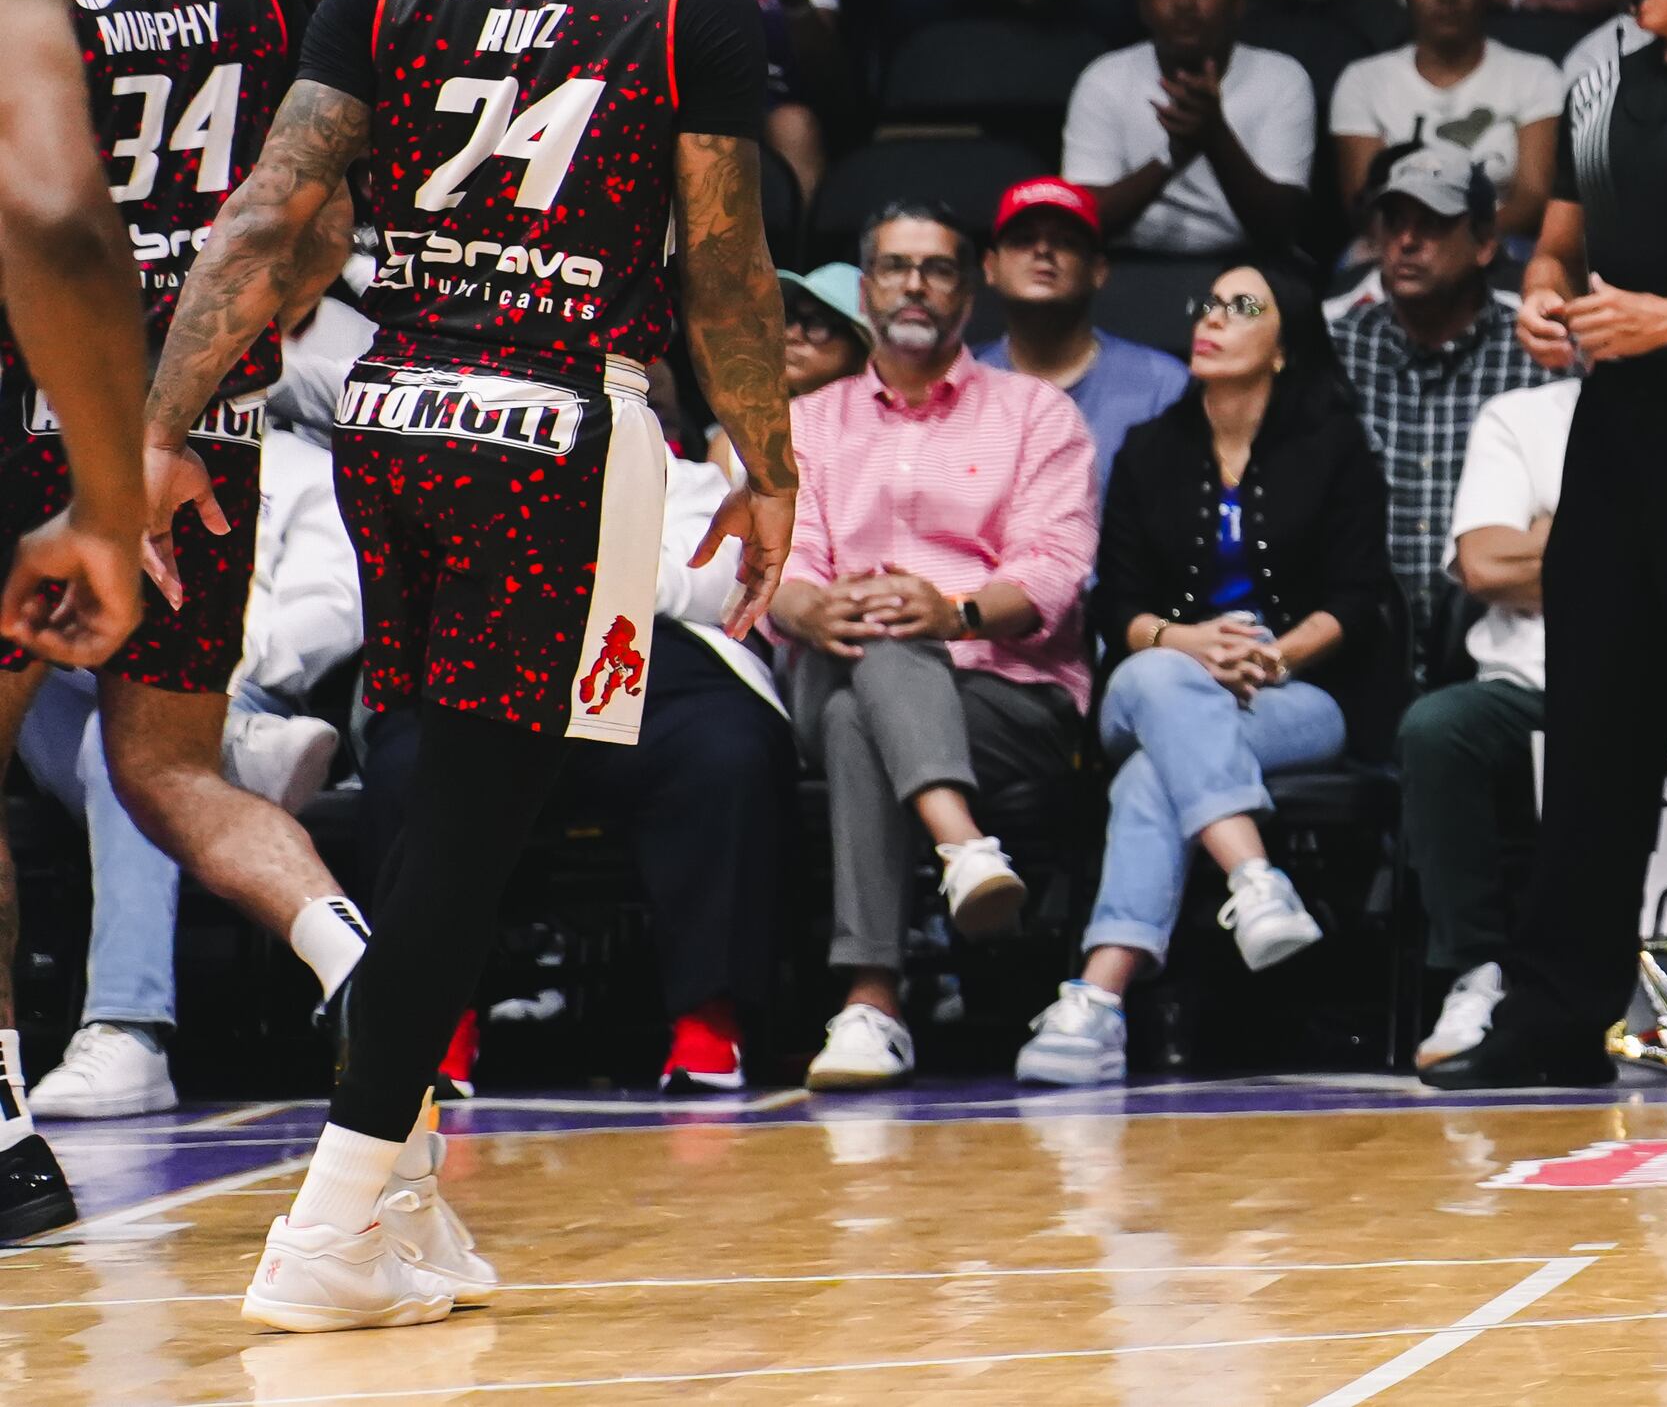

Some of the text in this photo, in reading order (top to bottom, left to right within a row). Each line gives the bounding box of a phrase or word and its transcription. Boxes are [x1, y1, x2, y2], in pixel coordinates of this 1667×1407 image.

[96, 1, 219, 56] MURPHY
[110, 62, 243, 203] 34
[414, 76, 607, 212] 24
[423, 272, 596, 321] lubricants
